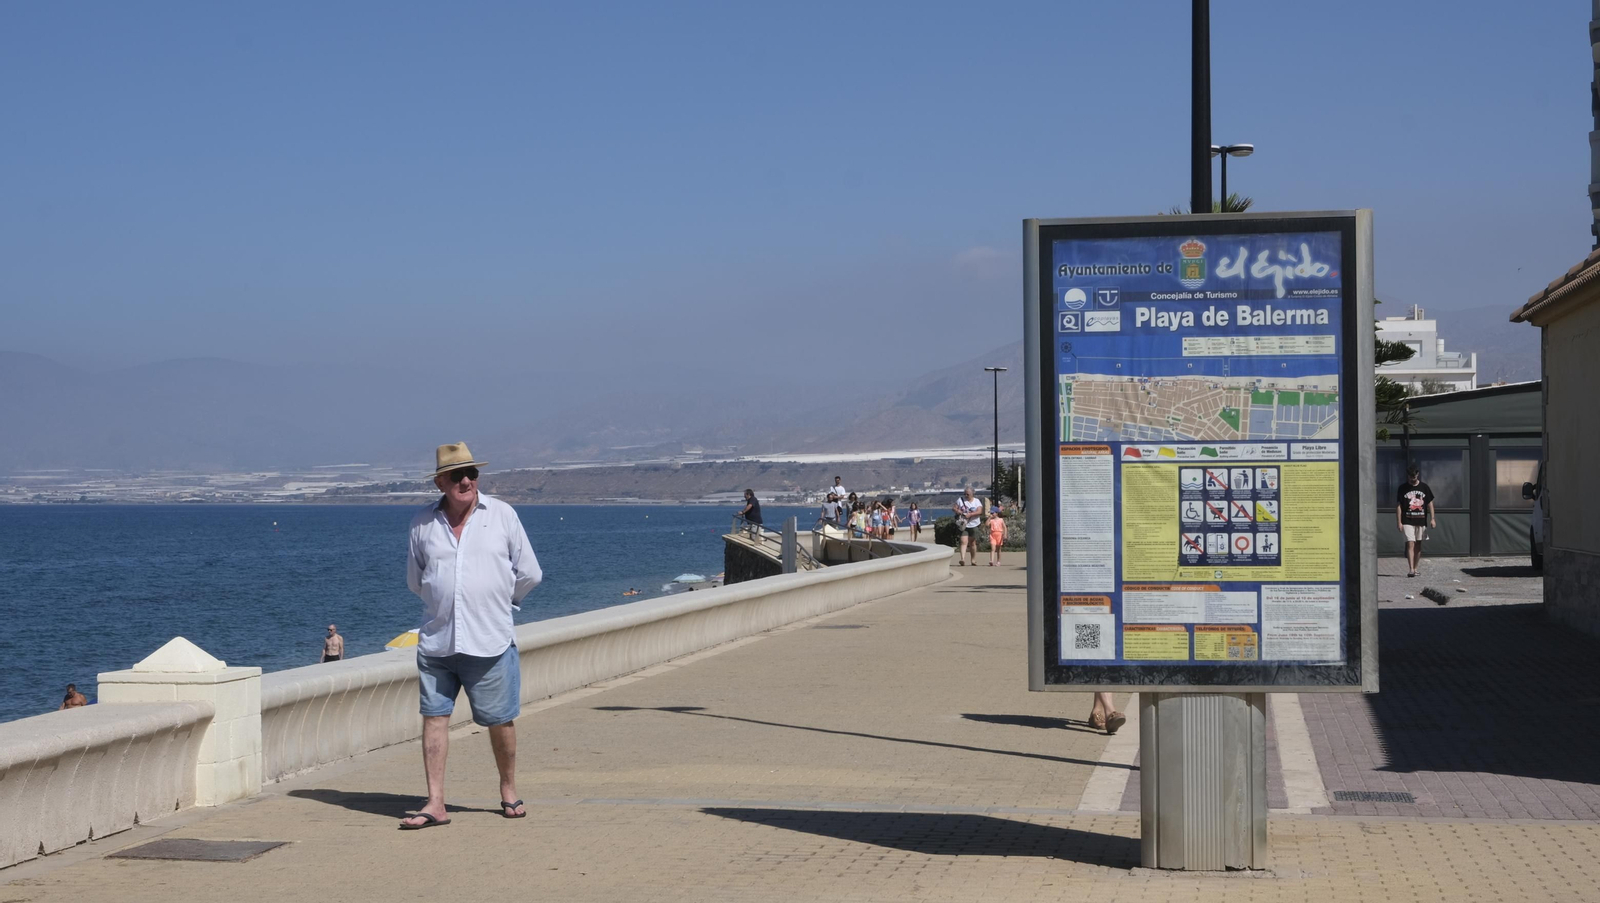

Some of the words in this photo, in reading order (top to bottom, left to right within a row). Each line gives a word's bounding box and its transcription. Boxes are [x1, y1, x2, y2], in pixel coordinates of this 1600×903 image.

[1058, 262, 1152, 279] Ayuntamiento
[1156, 261, 1173, 274] de
[1194, 291, 1204, 299] de
[1205, 290, 1238, 299] Turismo
[1135, 306, 1195, 332] Playa
[1201, 305, 1230, 327] de
[1236, 304, 1330, 326] Balerma
